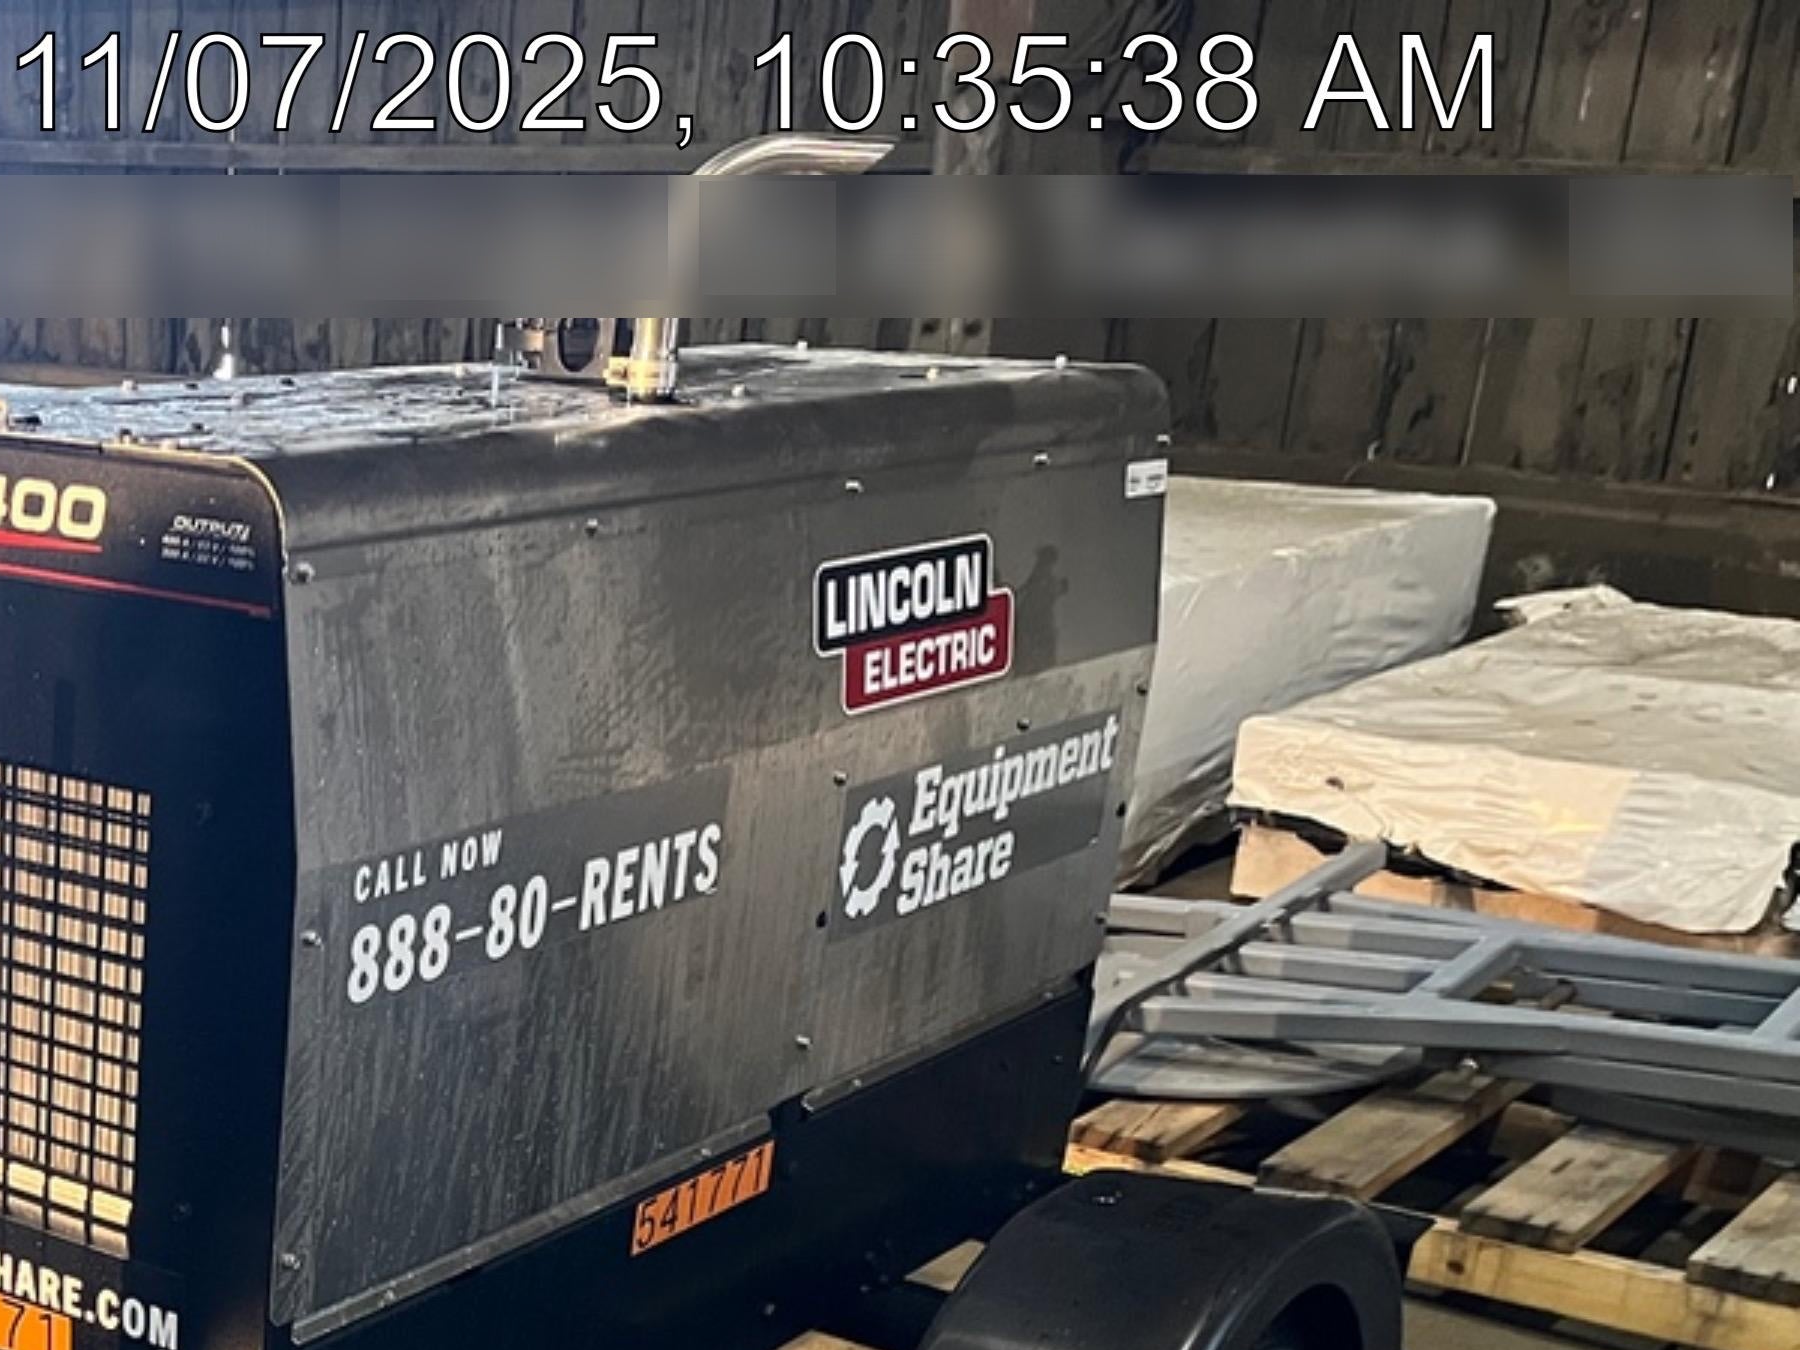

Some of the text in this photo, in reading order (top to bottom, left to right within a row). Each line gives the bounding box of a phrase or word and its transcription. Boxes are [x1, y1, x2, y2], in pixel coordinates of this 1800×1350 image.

[826, 551, 983, 640] LINCOLN
[863, 623, 997, 695] ELECTRIC
[908, 714, 1121, 839] Equipment
[354, 829, 502, 902] CALL NOW
[897, 831, 1016, 916] Share
[347, 823, 722, 1004] 888-80-RENTS
[637, 1148, 763, 1249] 541771
